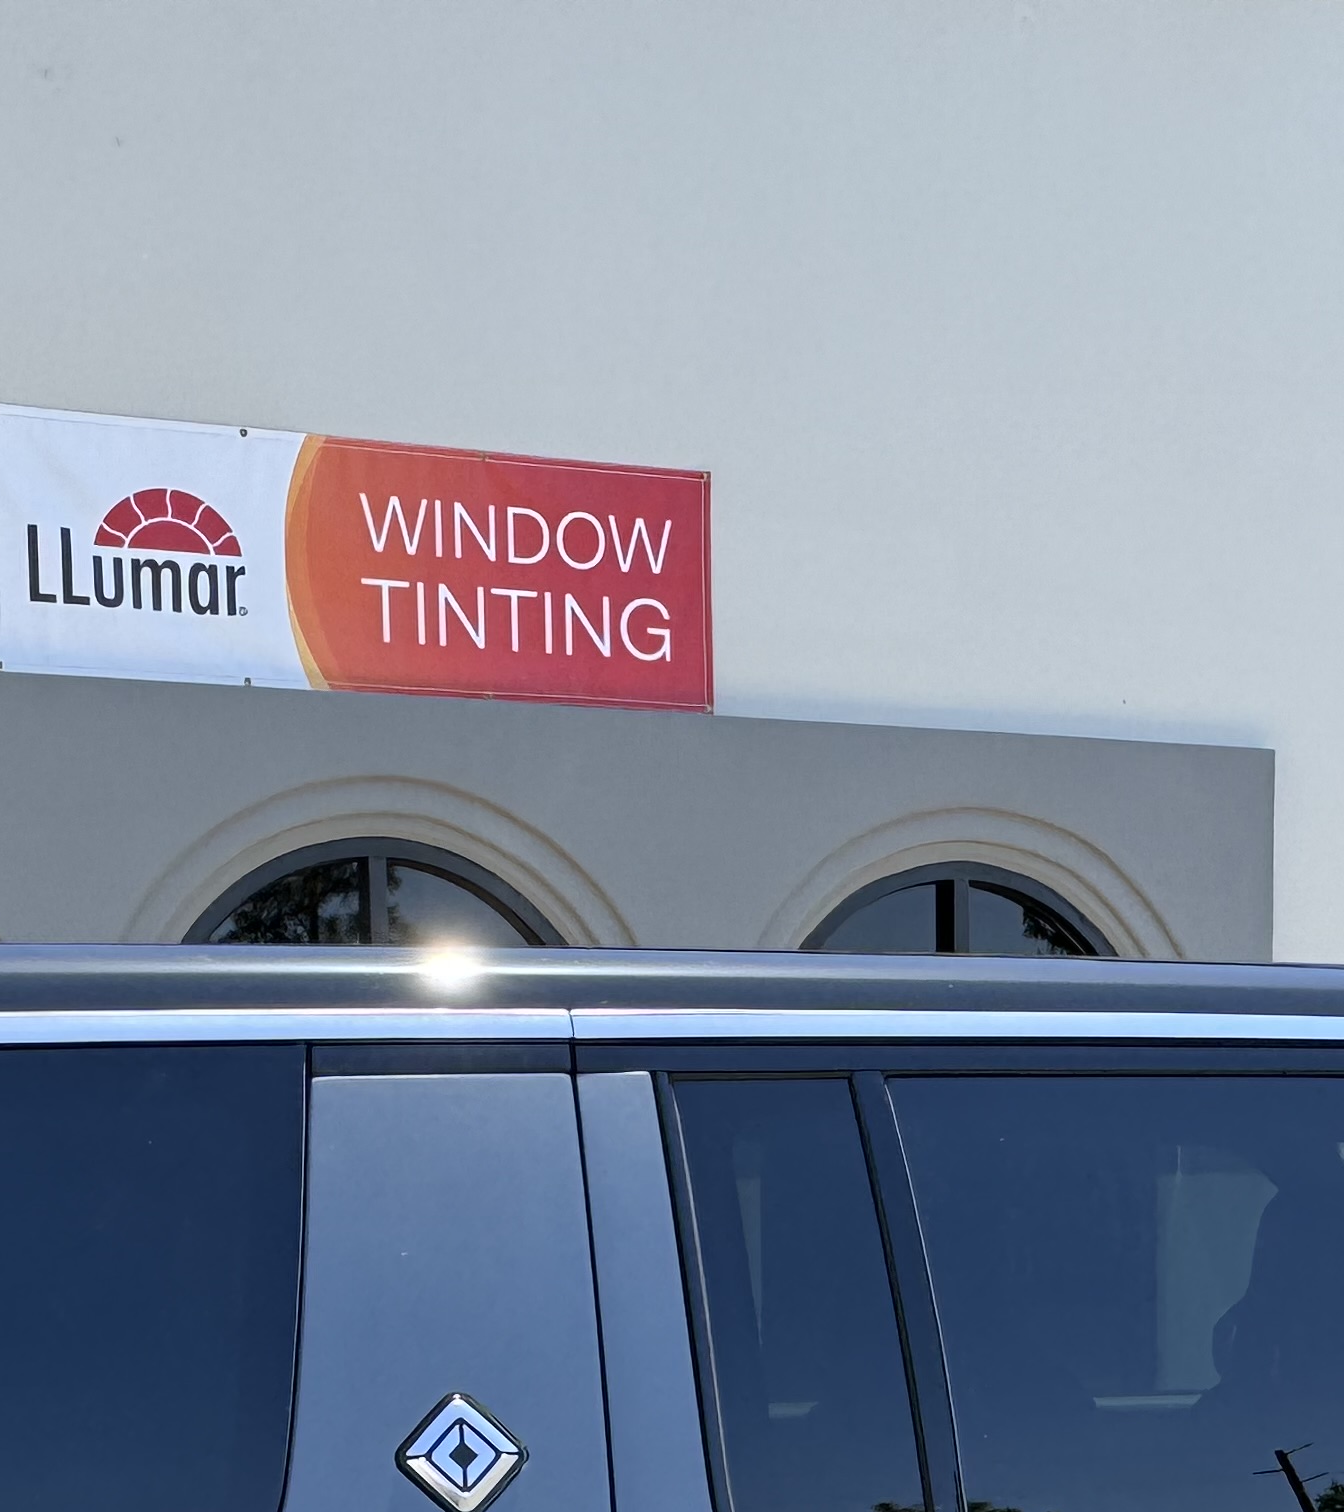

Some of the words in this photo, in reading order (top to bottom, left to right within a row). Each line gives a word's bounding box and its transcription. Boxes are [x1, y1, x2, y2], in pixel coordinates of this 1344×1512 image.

[26, 523, 246, 616] LLumar
[359, 492, 672, 575] WINDOW
[360, 577, 672, 663] TINTING
